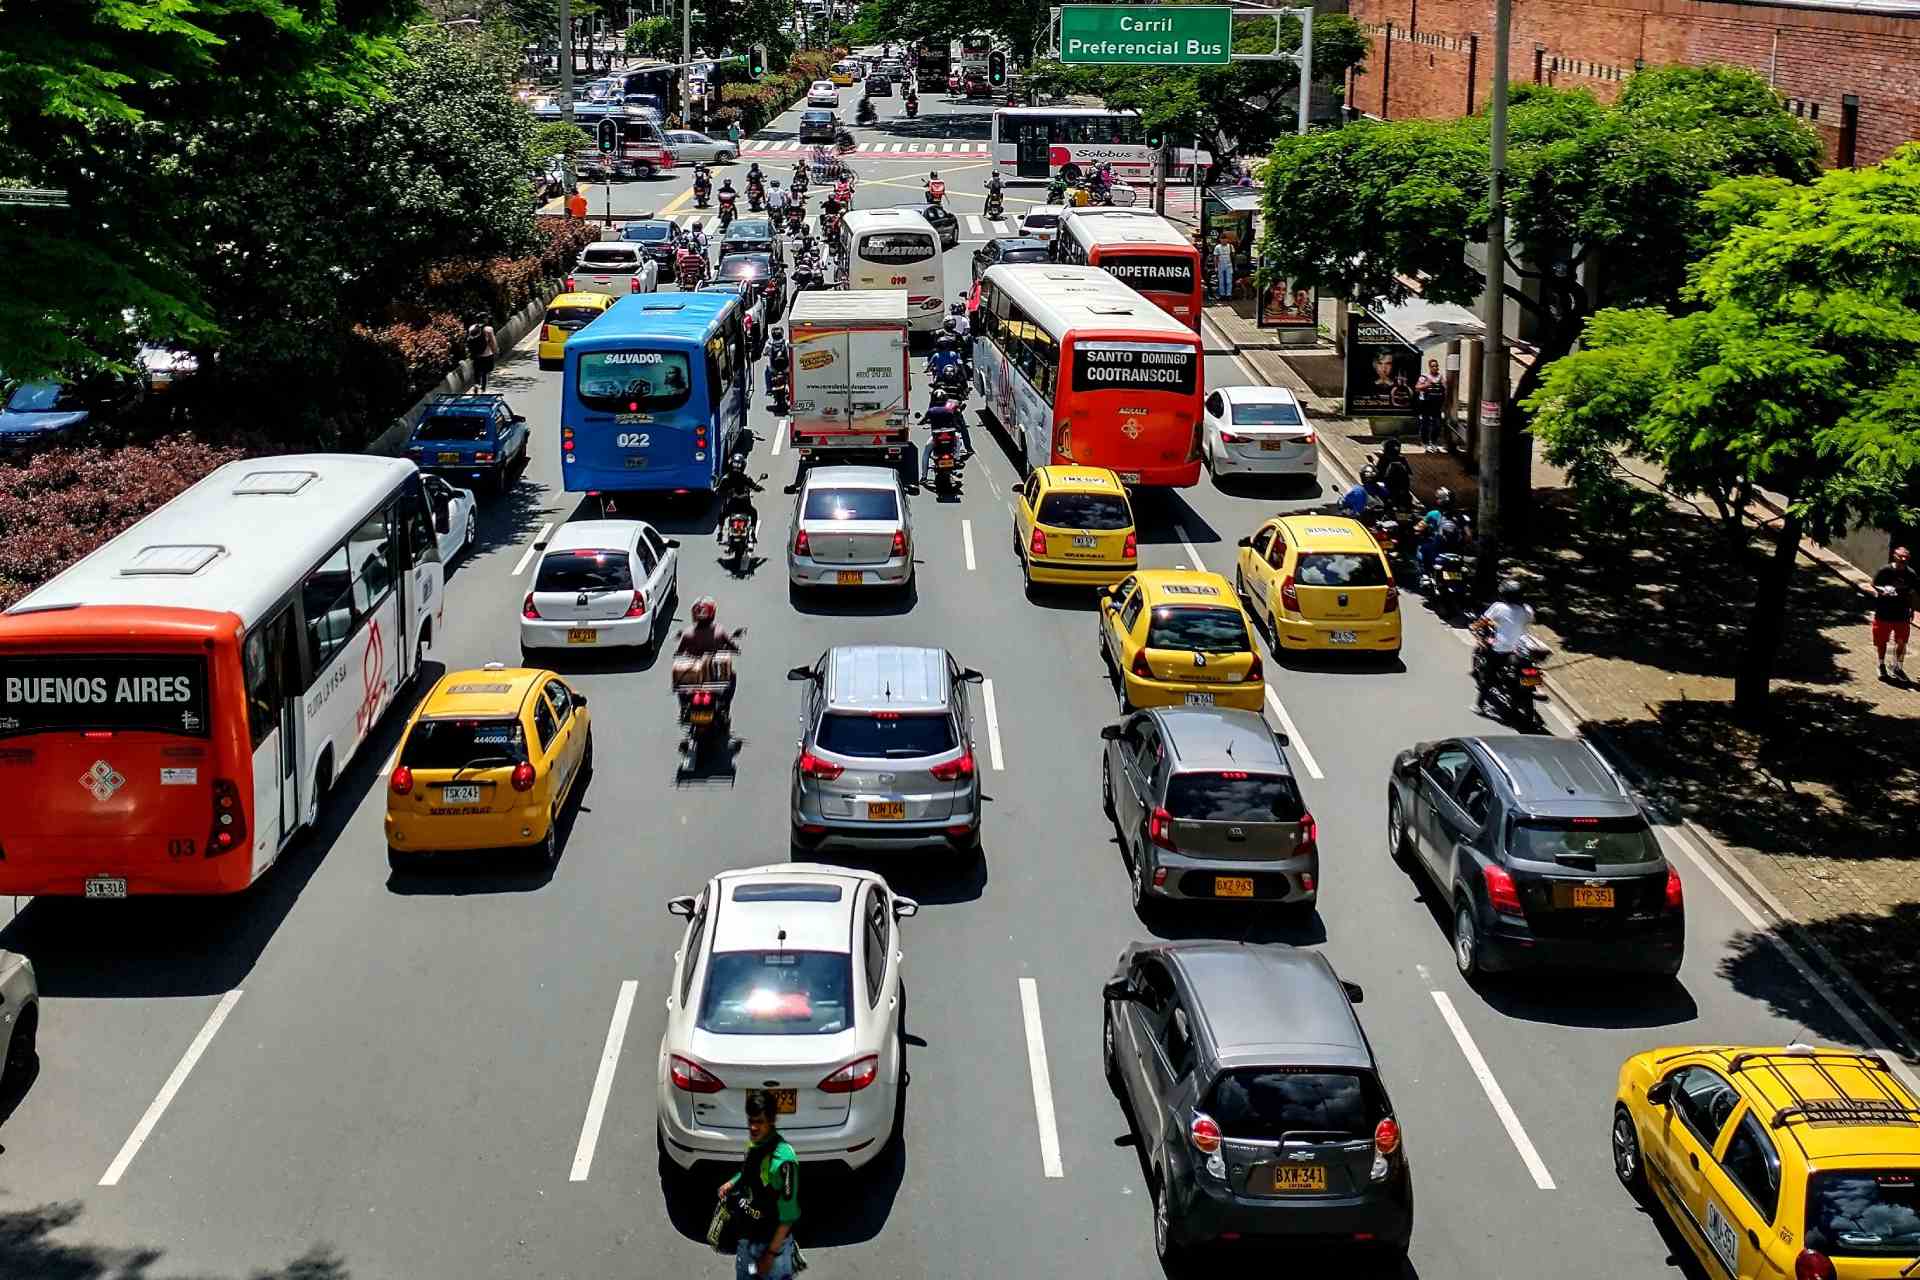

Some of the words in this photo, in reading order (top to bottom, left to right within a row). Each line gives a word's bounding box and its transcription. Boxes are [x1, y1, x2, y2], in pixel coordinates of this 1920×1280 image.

[1120, 17, 1172, 31] Carril
[1069, 39, 1178, 54] Preferencial
[1186, 39, 1222, 54] Bus
[1076, 149, 1133, 158] Solobus
[604, 353, 663, 364] SALVADOR
[1087, 351, 1133, 362] SANTO
[1141, 353, 1187, 364] DOMINGO
[1087, 367, 1183, 383] COOTRANSCOL
[617, 433, 650, 448] 022
[6, 677, 107, 703] BUENOS
[115, 676, 191, 703] AIRES
[168, 839, 196, 857] 03
